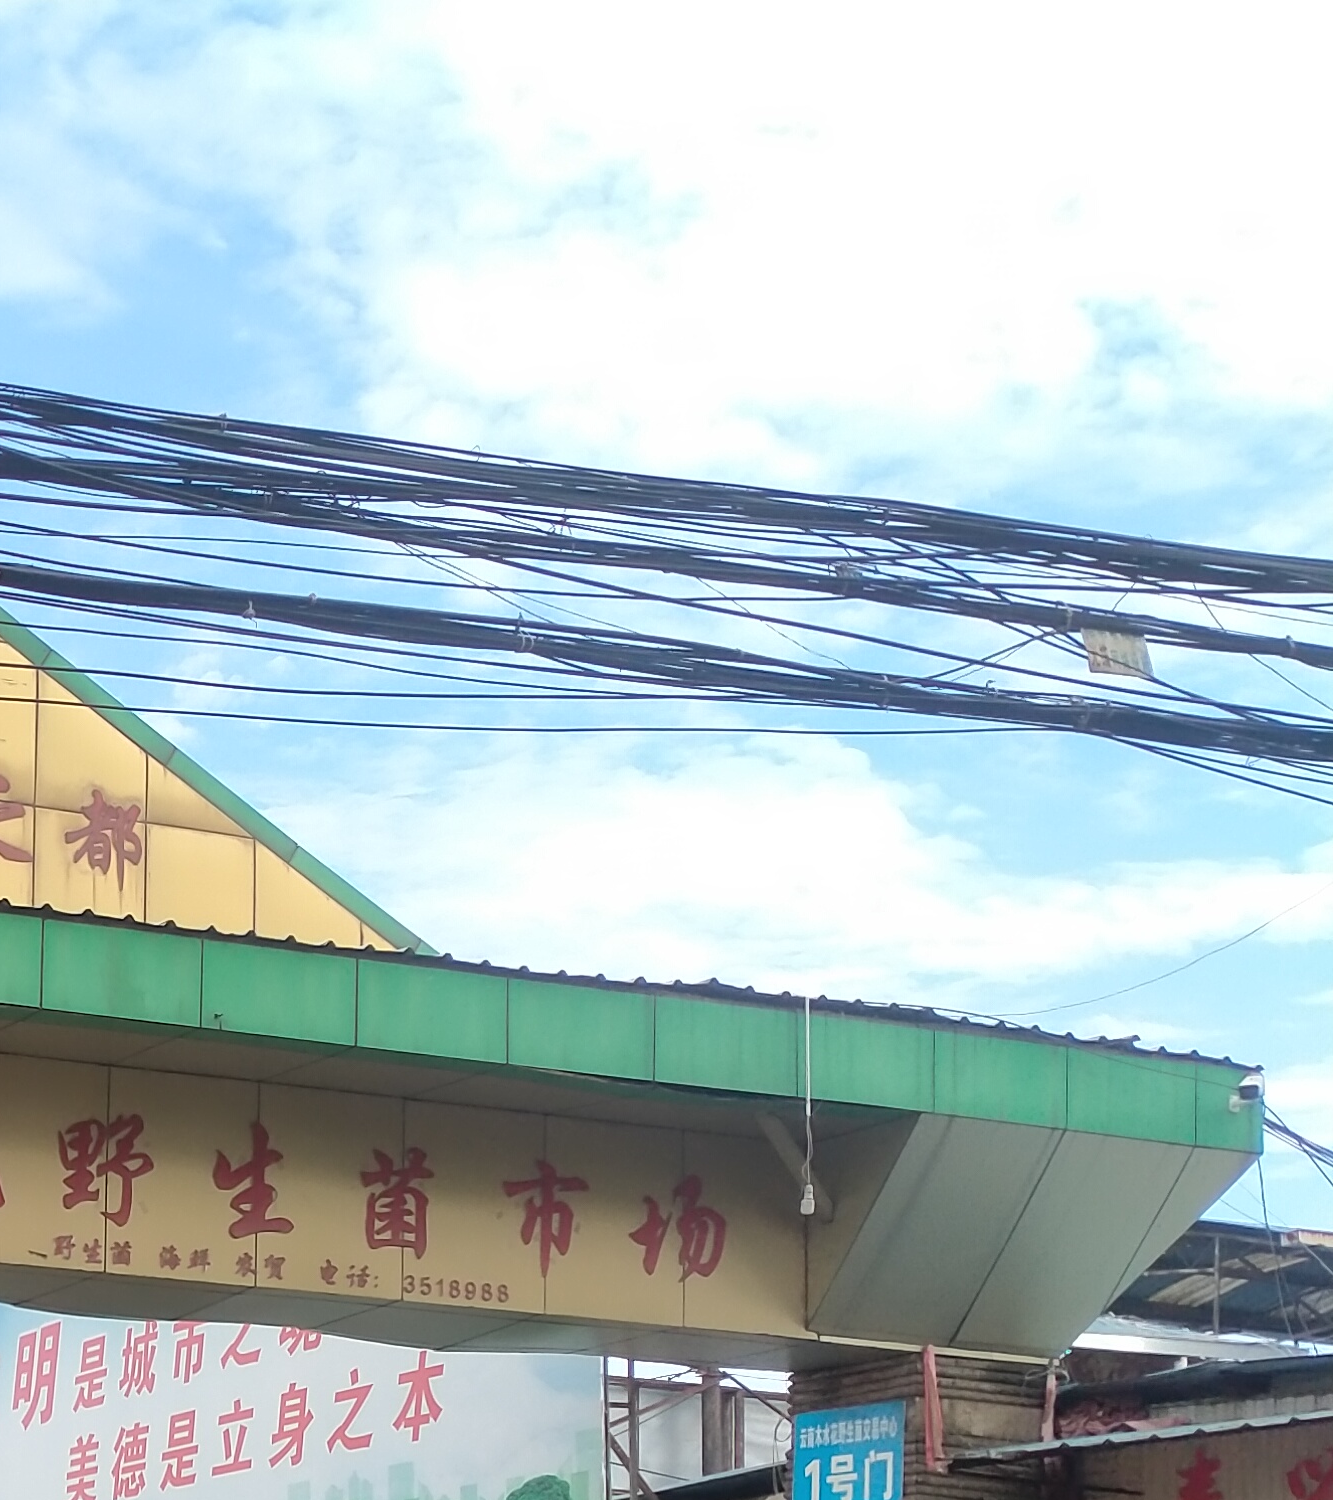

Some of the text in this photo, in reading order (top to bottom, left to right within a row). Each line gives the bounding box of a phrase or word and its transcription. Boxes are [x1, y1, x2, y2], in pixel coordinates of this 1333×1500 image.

[52, 1234, 133, 1267] 野生菌
[159, 1246, 212, 1273] 海鲜
[234, 1252, 288, 1281] 农贸
[402, 1273, 510, 1304] 3518988
[799, 1415, 899, 1449] 云南木水花野生菌交易中心
